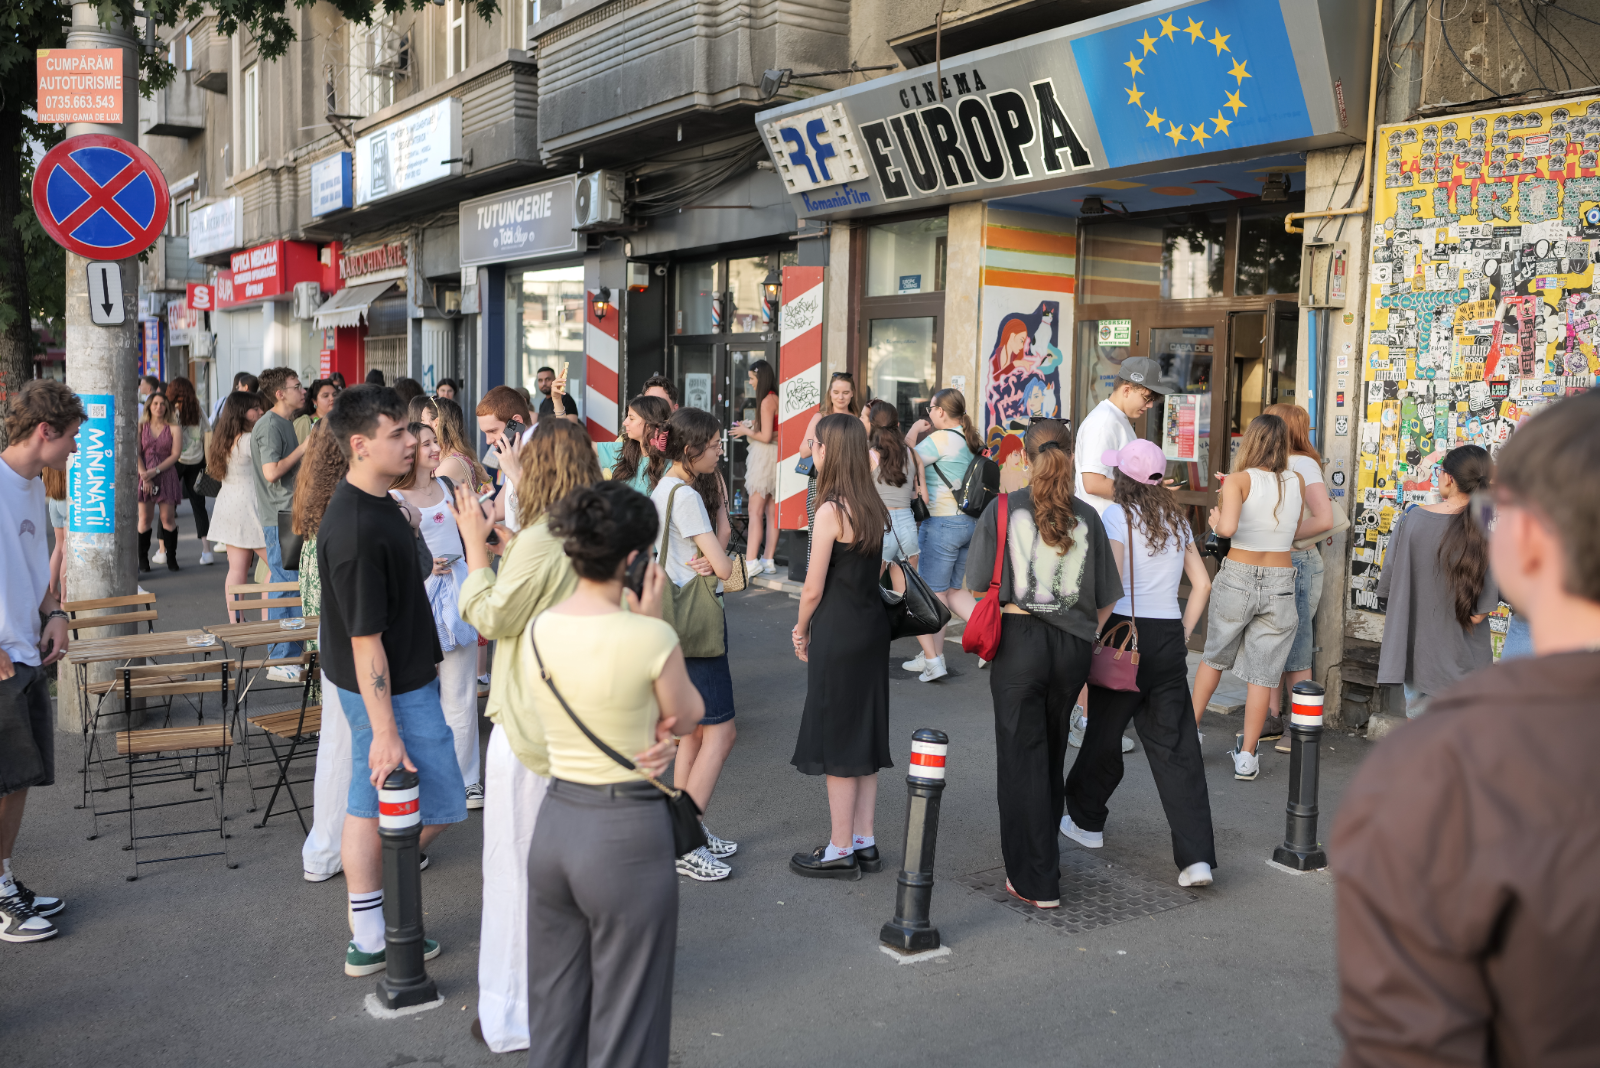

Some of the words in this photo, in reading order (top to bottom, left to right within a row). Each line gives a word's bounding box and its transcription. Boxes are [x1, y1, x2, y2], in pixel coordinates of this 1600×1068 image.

[46, 54, 114, 71] CUMPĂRĂM
[39, 75, 122, 90] AUTOTURISME
[899, 69, 987, 109] CINEMA
[45, 95, 115, 109] 0735.663.543
[40, 113, 72, 122] INCLUSIV
[72, 113, 94, 121] GAMA
[95, 113, 105, 121] DE
[106, 113, 120, 121] LUX
[858, 77, 1094, 203] EUROPA
[477, 191, 553, 231] TUTUNGERIE
[232, 252, 250, 274] OPTICA
[250, 244, 278, 269] MEDICALA
[1169, 343, 1193, 351] CASA
[73, 471, 82, 526] PALATULUI
